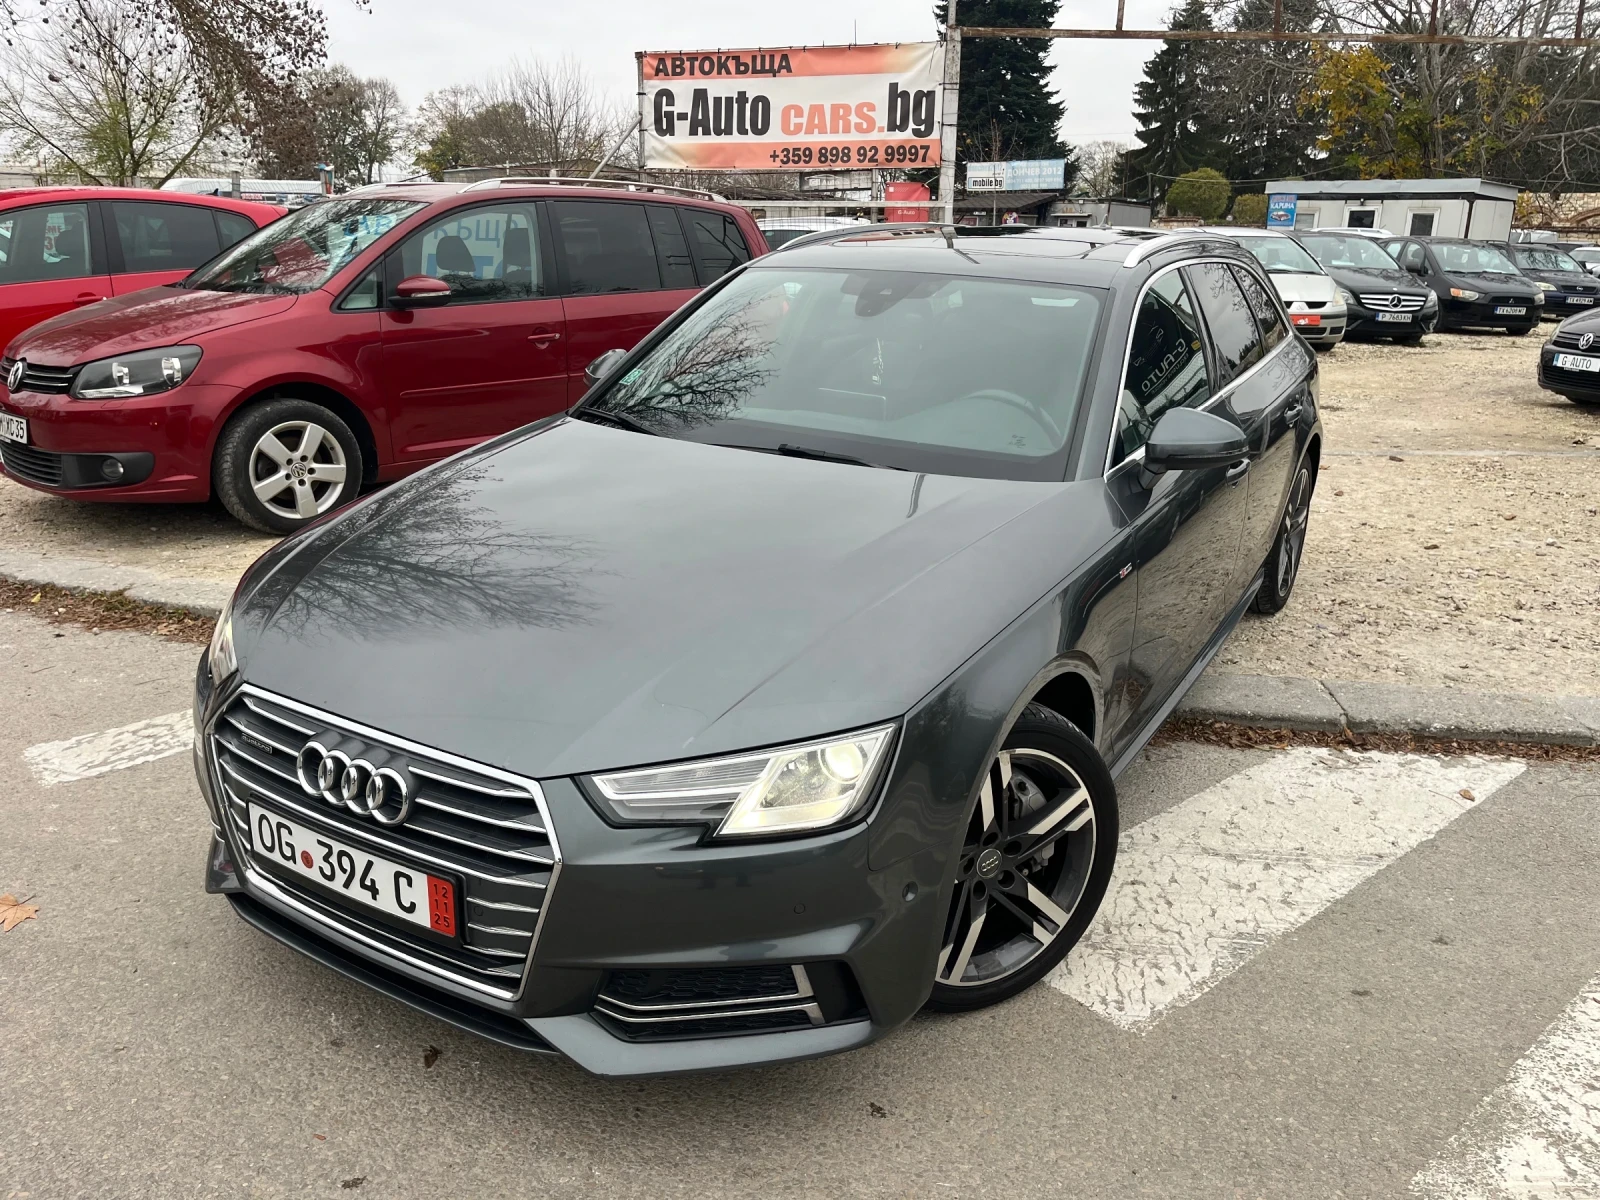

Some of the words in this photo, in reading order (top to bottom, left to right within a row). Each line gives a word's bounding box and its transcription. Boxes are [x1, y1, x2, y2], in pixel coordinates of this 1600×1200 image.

[654, 53, 793, 77] АВТОКЪЩА
[653, 88, 771, 137] G-Auto
[769, 146, 813, 164] +359
[817, 145, 852, 164] 898
[857, 145, 879, 163] 92
[884, 144, 930, 163] 9997
[1042, 167, 1062, 175] 2012
[258, 813, 297, 865] OG
[316, 838, 380, 901] 394
[393, 870, 417, 914] C
[432, 883, 448, 899] 12
[434, 898, 449, 913] 11
[434, 913, 450, 928] 25
